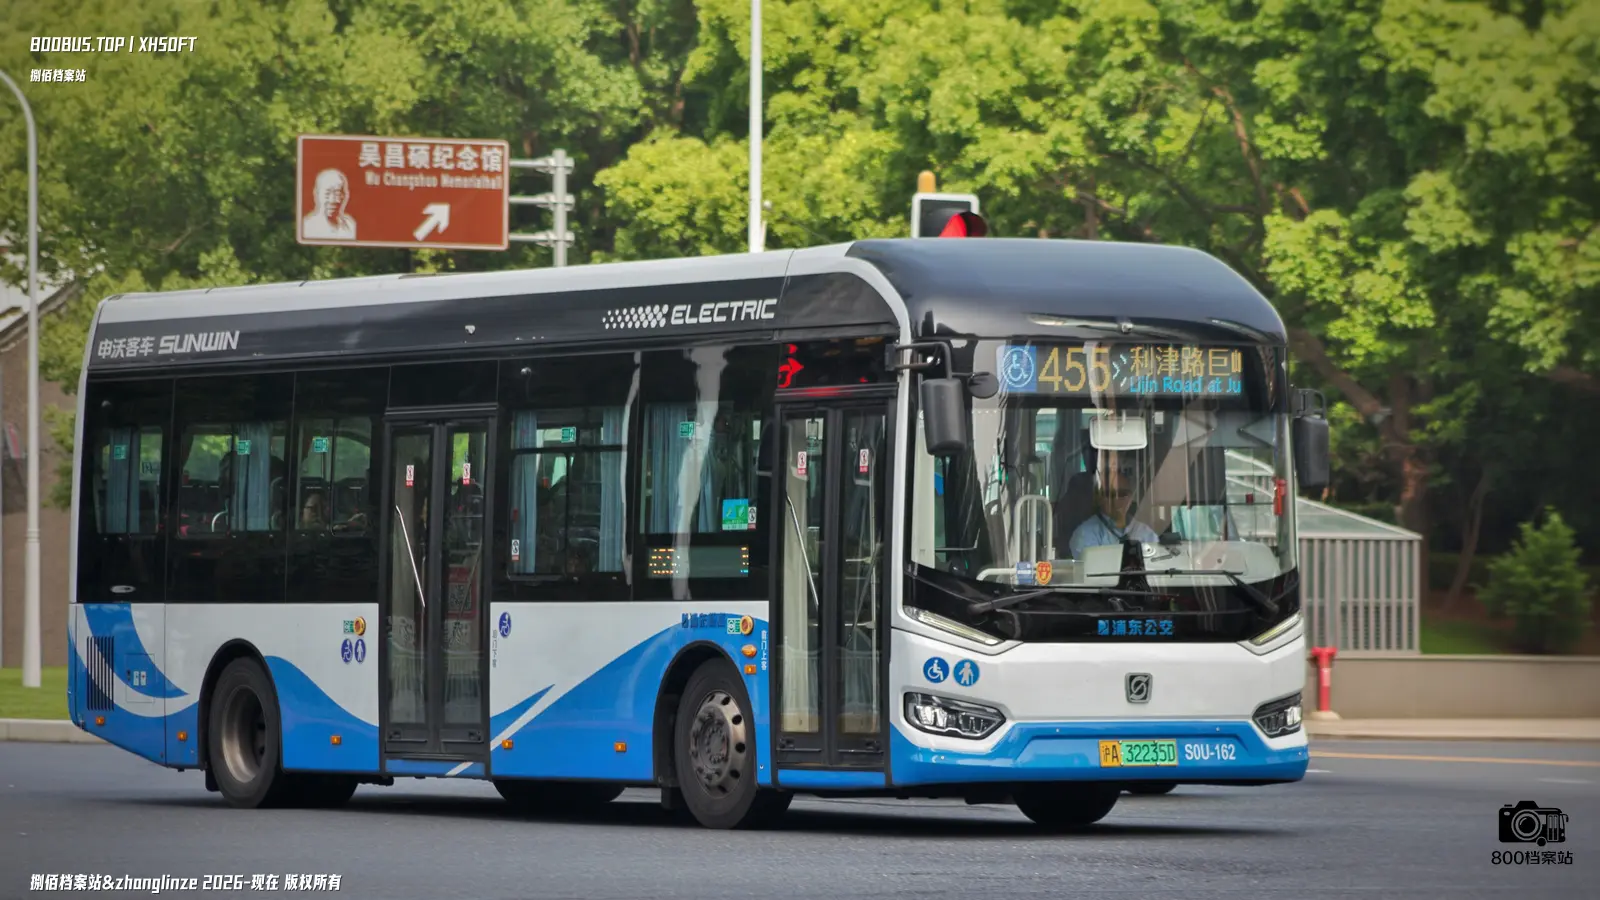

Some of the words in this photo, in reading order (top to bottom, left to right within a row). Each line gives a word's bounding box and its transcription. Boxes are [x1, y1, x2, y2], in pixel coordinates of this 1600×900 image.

[358, 142, 503, 172] 吴昌硕纪念馆
[365, 171, 381, 186] Wu
[383, 171, 438, 190] Changshuo
[670, 298, 778, 325] ELECTRIC
[97, 336, 155, 359] 申沃客车
[158, 330, 240, 355] SUNWIN
[1037, 346, 1112, 392] 455
[1129, 376, 1158, 395] Lijin
[1162, 376, 1203, 394] Road
[1207, 377, 1223, 394] at
[1111, 619, 1174, 636] 浦东公交
